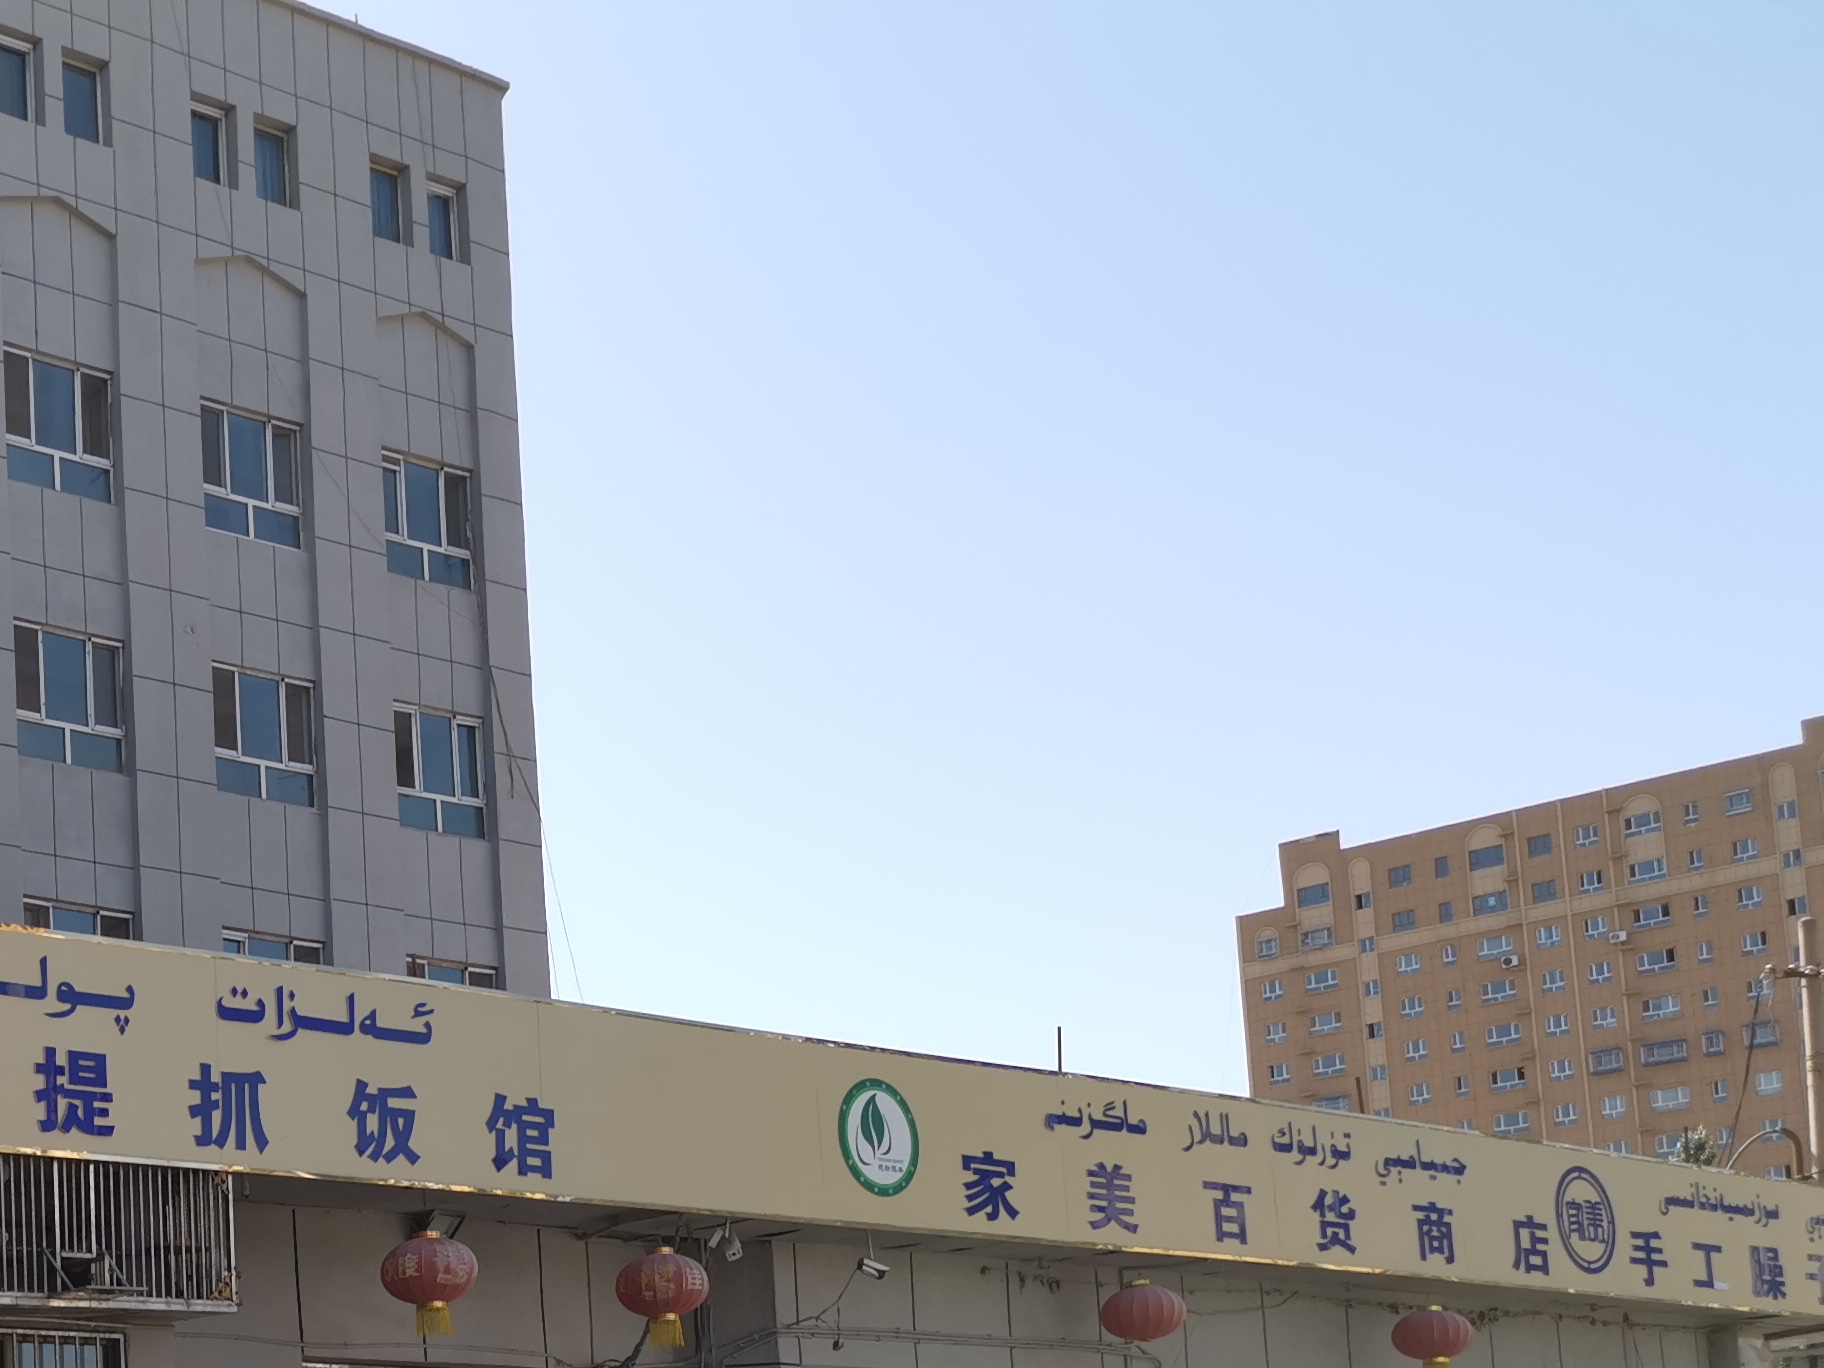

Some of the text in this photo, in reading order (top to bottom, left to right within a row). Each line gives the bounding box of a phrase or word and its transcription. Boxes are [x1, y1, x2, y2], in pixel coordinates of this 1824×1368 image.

[962, 1151, 1550, 1277] 家美百货商店
